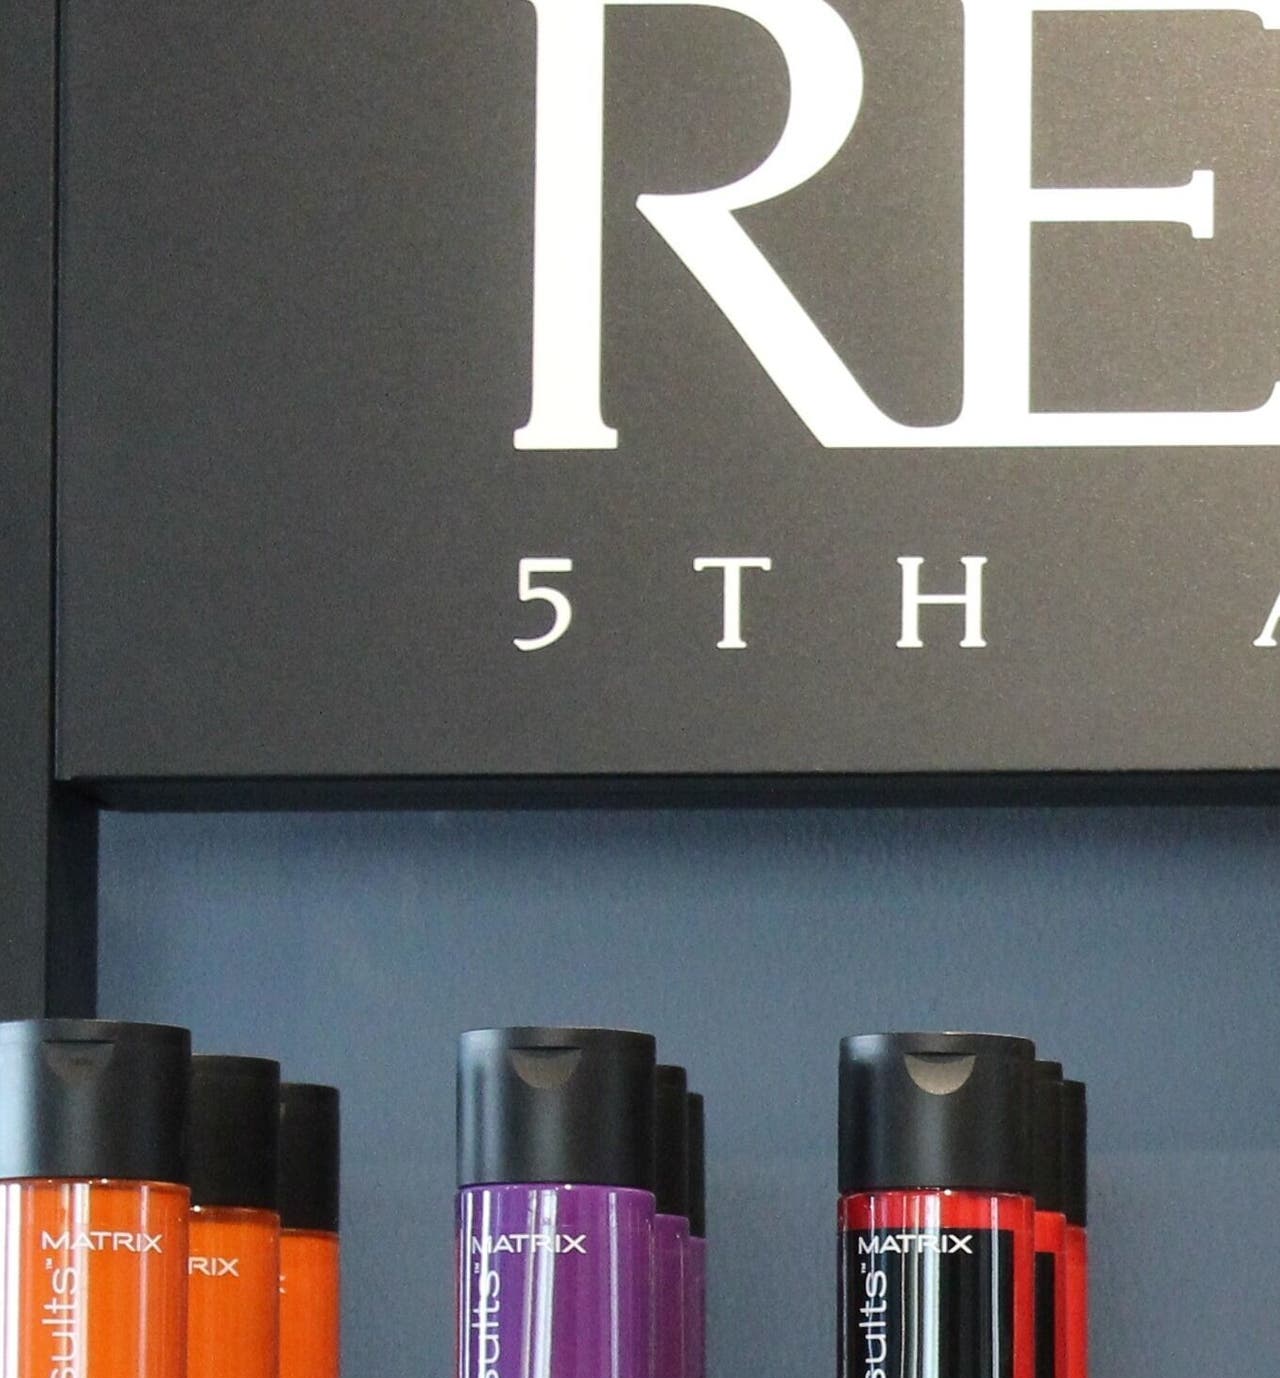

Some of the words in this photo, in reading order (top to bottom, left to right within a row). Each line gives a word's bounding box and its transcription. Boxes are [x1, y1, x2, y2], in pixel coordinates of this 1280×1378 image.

[513, 555, 987, 650] 5TH
[41, 1231, 163, 1253] MATRIX
[472, 1234, 587, 1254] MATRIX
[858, 1234, 973, 1254] MATRIX
